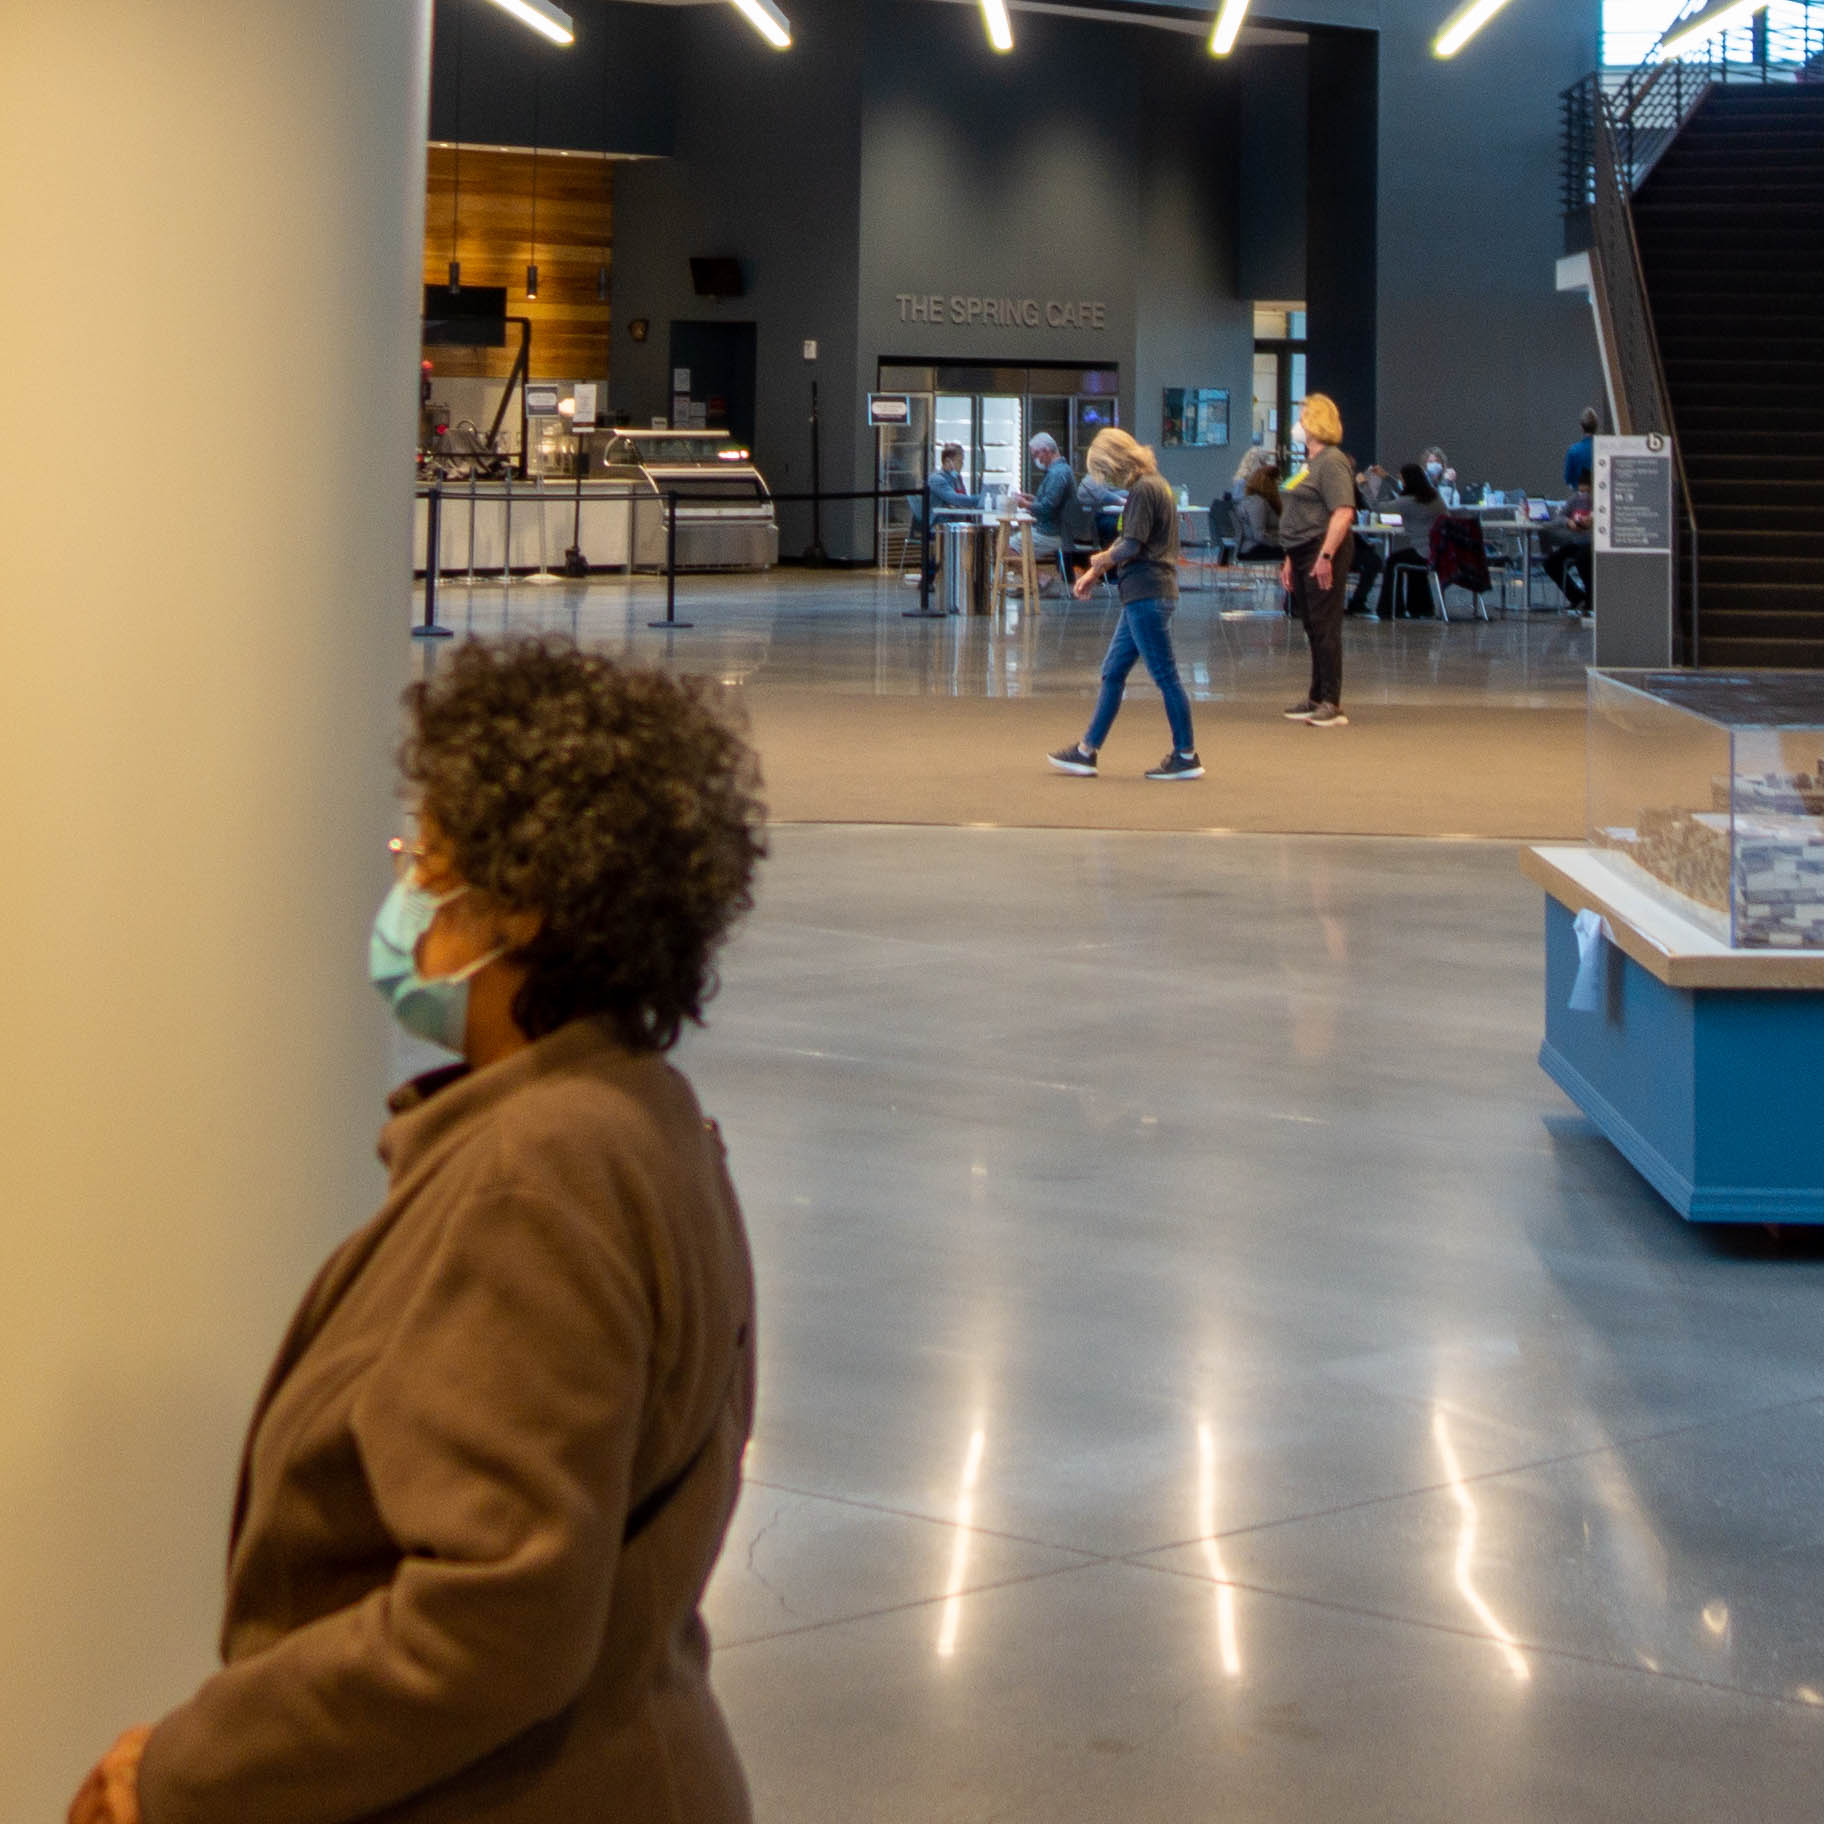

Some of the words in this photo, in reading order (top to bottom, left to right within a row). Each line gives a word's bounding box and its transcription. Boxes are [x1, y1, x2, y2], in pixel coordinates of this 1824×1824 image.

[895, 294, 945, 325] THE
[950, 296, 1040, 328] SPRING
[1046, 300, 1107, 330] CAFE
